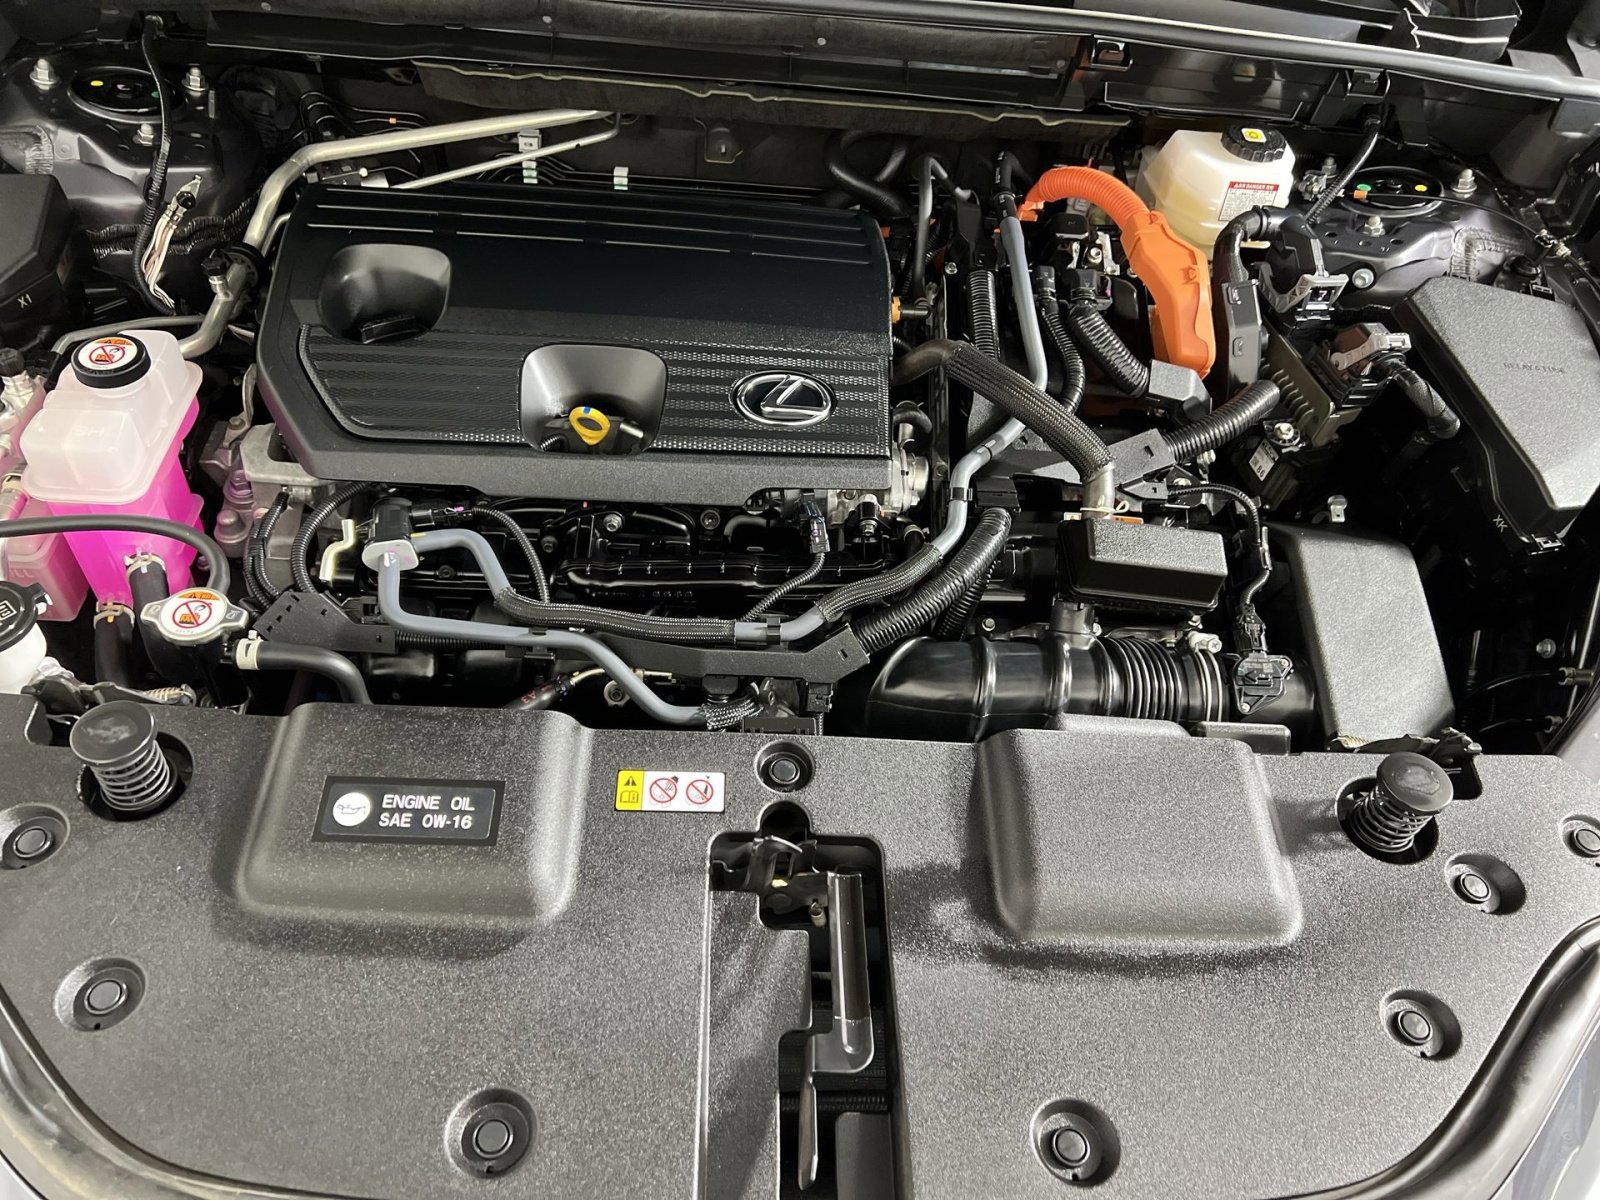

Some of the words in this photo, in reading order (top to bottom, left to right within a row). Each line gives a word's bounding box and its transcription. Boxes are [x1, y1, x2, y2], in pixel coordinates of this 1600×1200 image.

[16, 293, 33, 309] X1
[1492, 514, 1508, 533] XK
[381, 794, 441, 810] ENGINE
[450, 796, 476, 812] OIL
[378, 812, 413, 828] SAE
[421, 813, 473, 830] 0W-16
